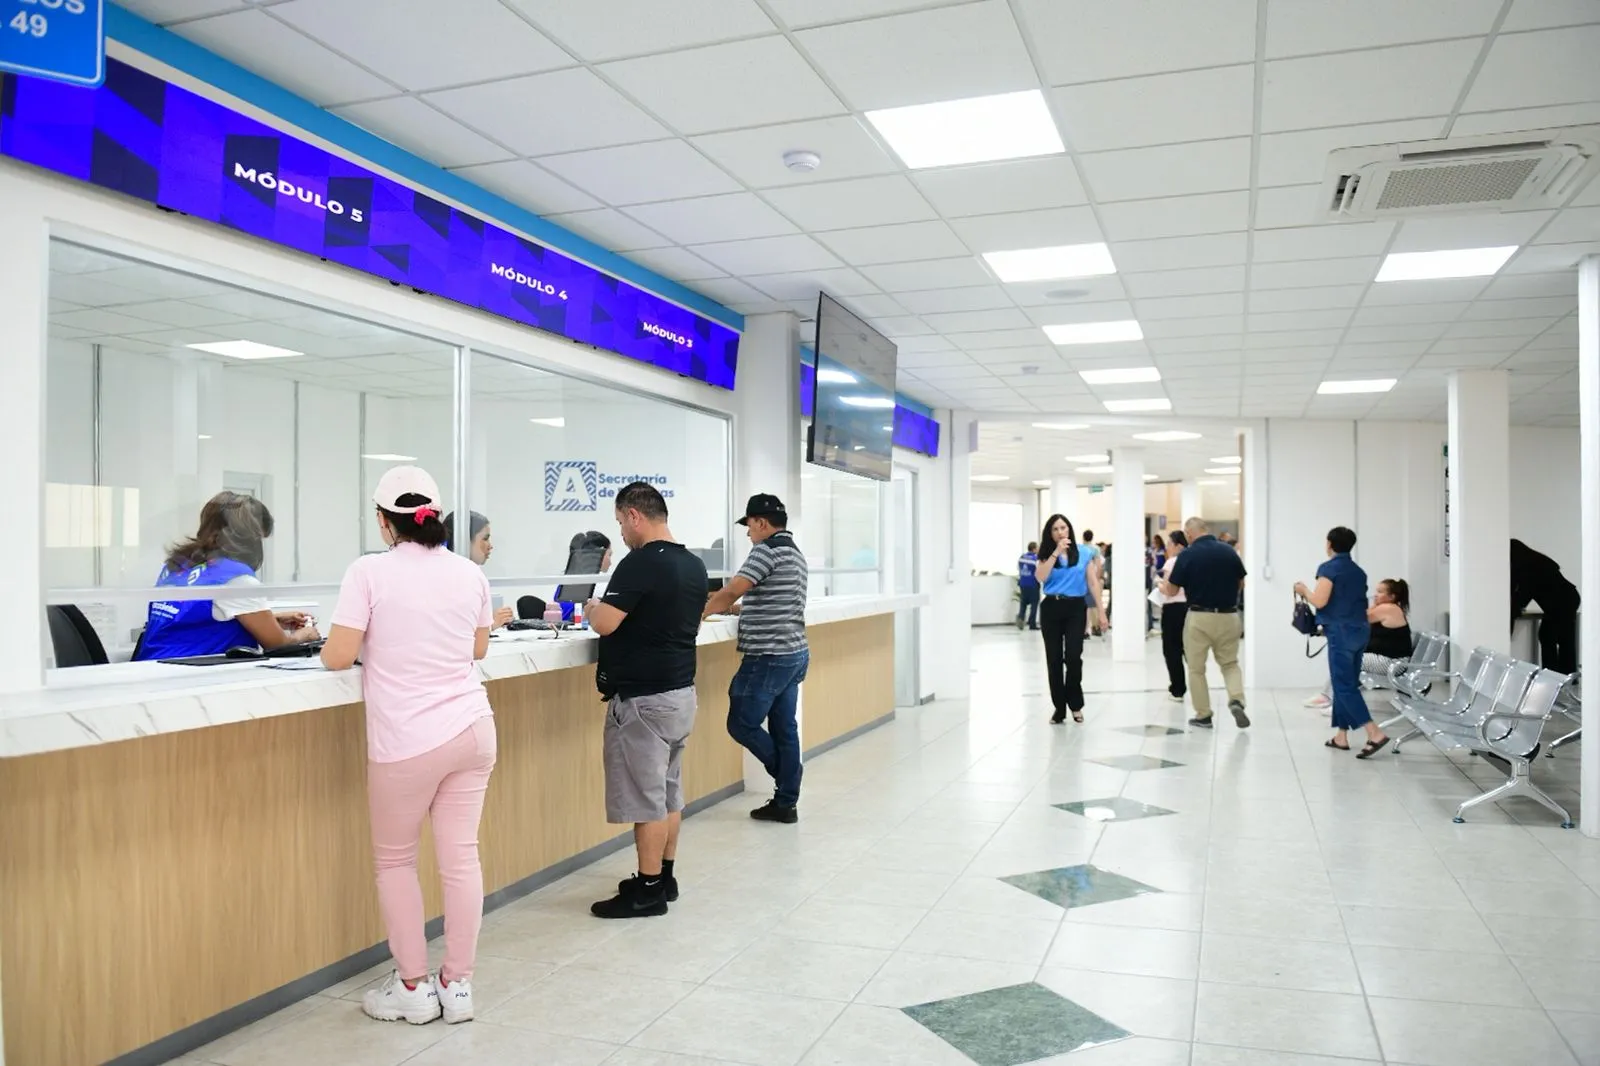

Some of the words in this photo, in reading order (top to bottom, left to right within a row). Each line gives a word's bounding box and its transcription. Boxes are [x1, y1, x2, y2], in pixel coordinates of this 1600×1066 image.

[9, 10, 48, 38] 49
[233, 162, 344, 215] MÓDULO
[350, 208, 363, 223] 5
[490, 262, 555, 295] MÓDULO
[558, 290, 568, 301] 4
[643, 321, 685, 345] MÓDULO
[686, 338, 694, 348] 3
[599, 473, 667, 485] Secretaría
[599, 487, 615, 498] de
